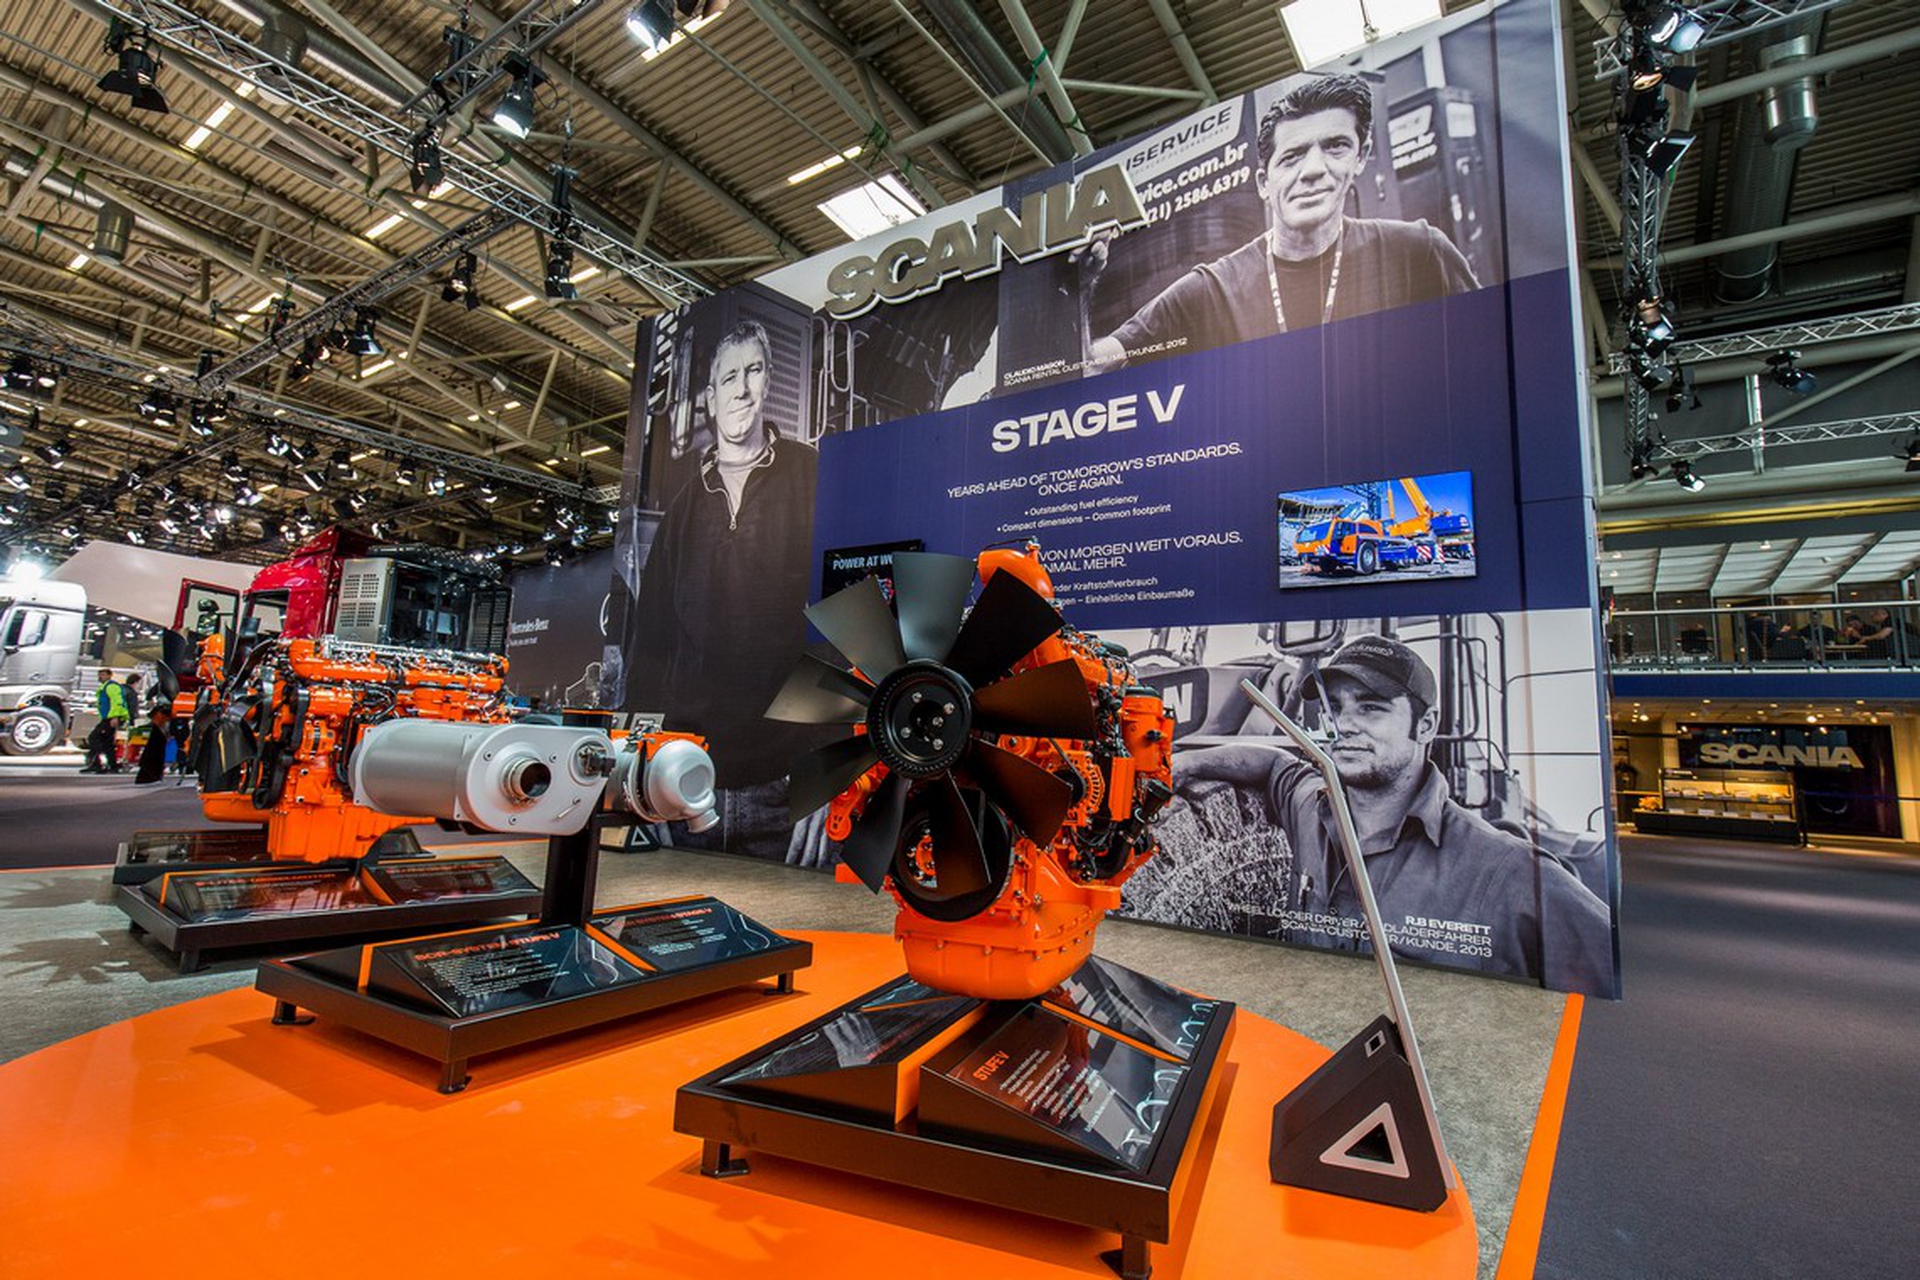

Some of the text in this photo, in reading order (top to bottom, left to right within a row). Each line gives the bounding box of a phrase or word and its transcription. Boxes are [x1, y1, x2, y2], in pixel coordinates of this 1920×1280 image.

[1174, 165, 1251, 213] 2586.6379
[826, 164, 1148, 319] SCANIA
[1003, 375, 1032, 386] SCANIA
[1032, 369, 1061, 380] RENTAL
[991, 384, 1186, 454] STAGE V
[947, 442, 1243, 498] YEARS AHEAD OF TOMORROW'S STANDARDS.
[1038, 473, 1123, 496] ONCE AGAIN.
[1030, 494, 1139, 517] Outstanding fuel efficiency
[1002, 503, 1171, 534] Compact dimensions Common footprint
[1038, 531, 1243, 562] VON MORGEN WEIT VORAUS.
[832, 557, 865, 570] POWER
[866, 555, 878, 567] AT
[1083, 556, 1127, 569] MEHR.
[1073, 577, 1158, 591] Kraftstoffverbrauch
[1085, 590, 1135, 604] Einheitliche
[1700, 743, 1864, 768] SCANIA
[1428, 919, 1491, 935] EVERETT
[1460, 944, 1493, 958] 2013
